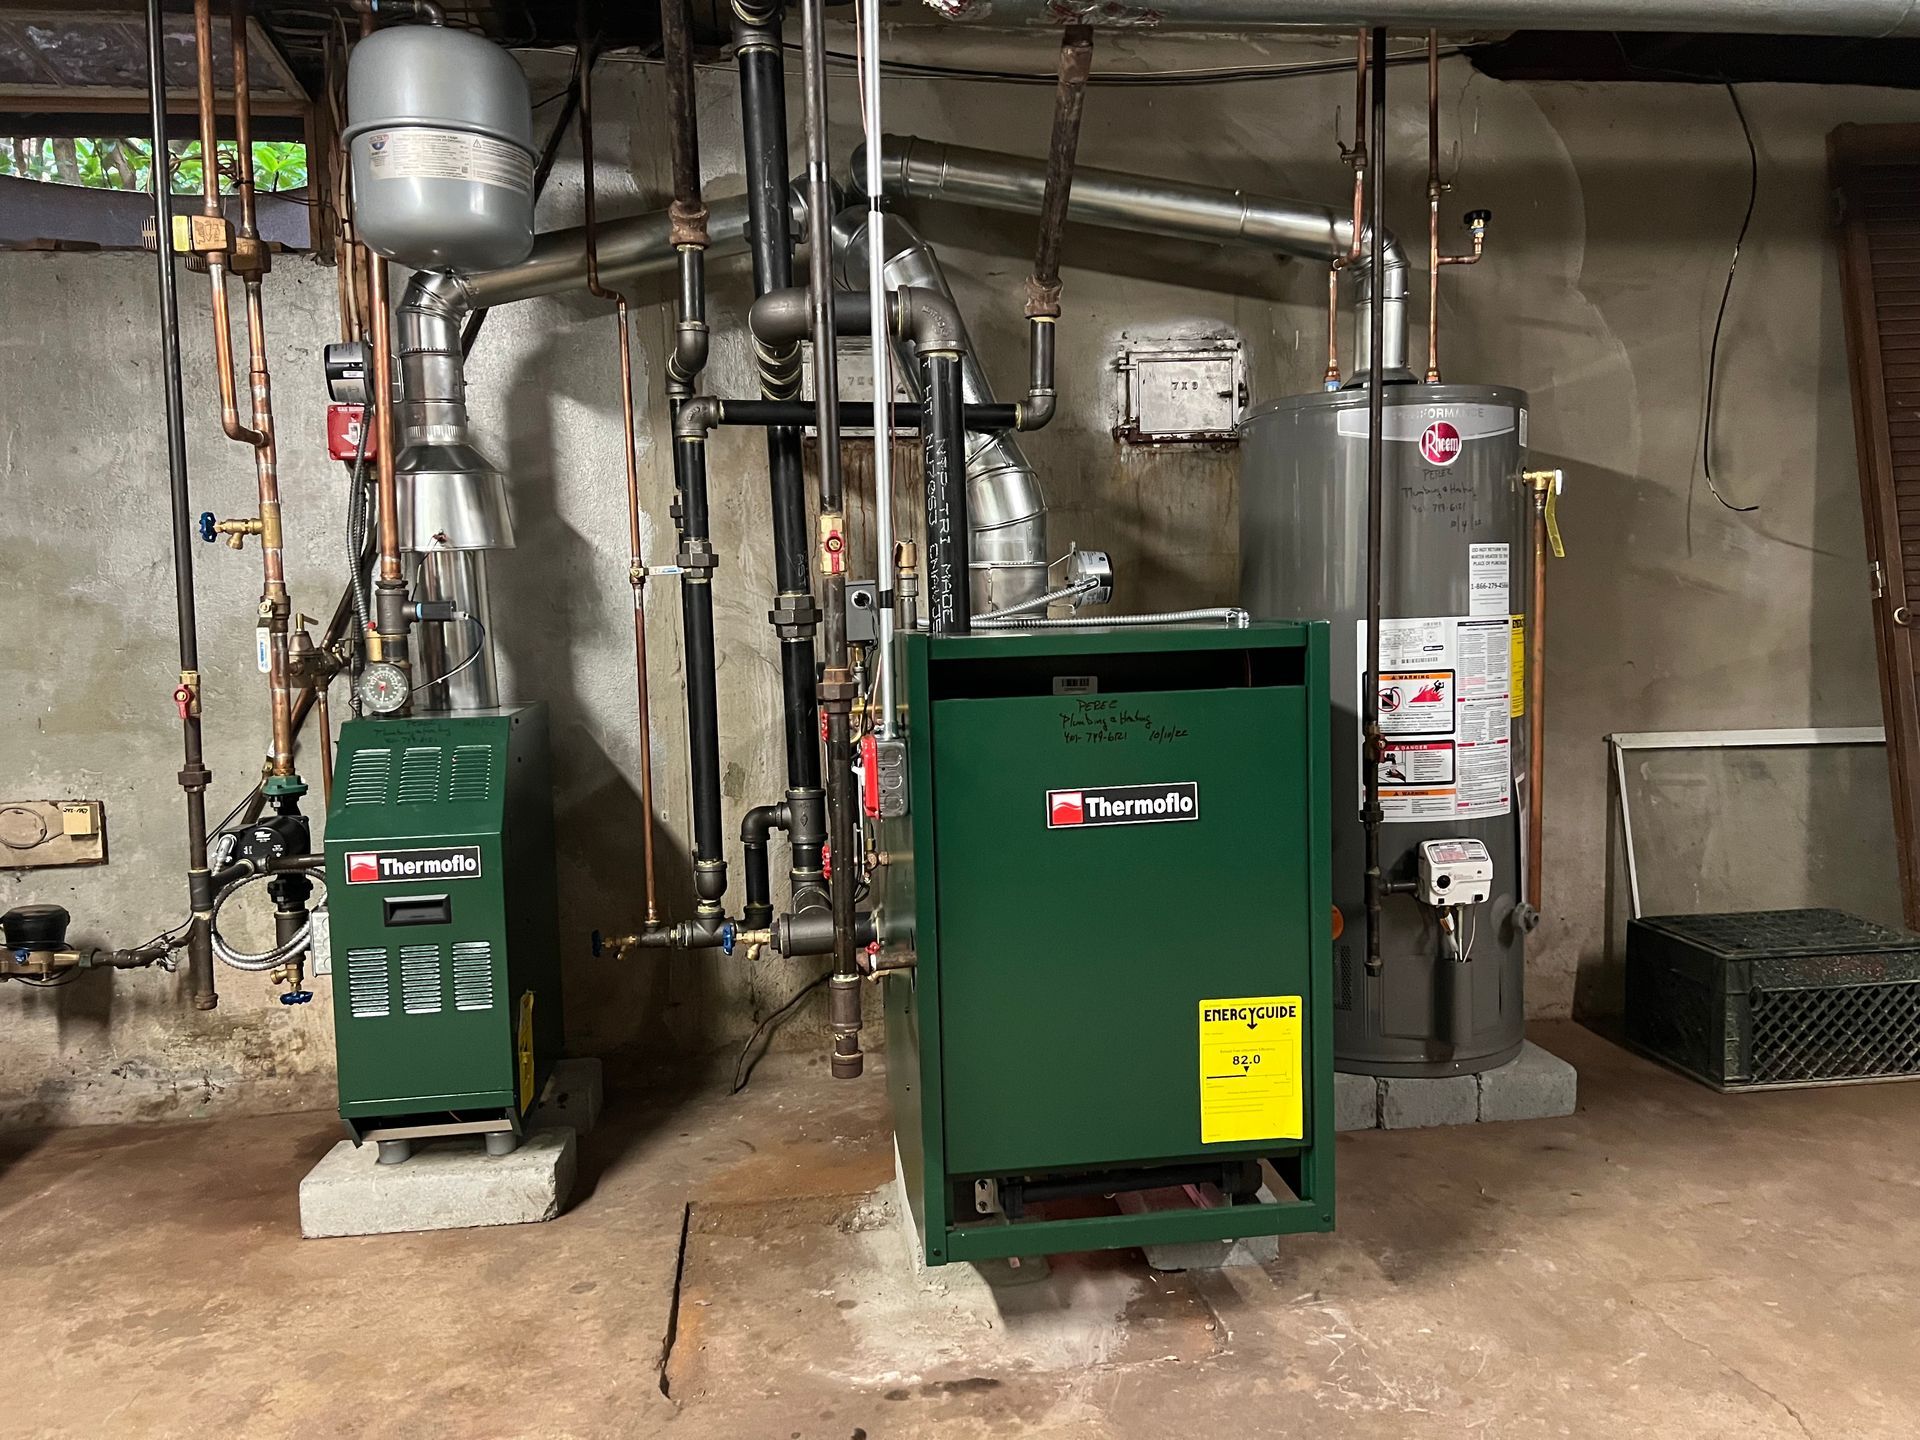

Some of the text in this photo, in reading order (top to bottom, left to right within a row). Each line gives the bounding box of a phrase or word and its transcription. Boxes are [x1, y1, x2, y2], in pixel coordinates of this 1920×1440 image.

[1425, 423, 1458, 458] Rheem
[1084, 792, 1194, 819] Thermoflo
[379, 854, 477, 876] Thermoflo
[1204, 1005, 1297, 1024] ENERGYGUIDE
[1232, 1054, 1261, 1066] 82.0
